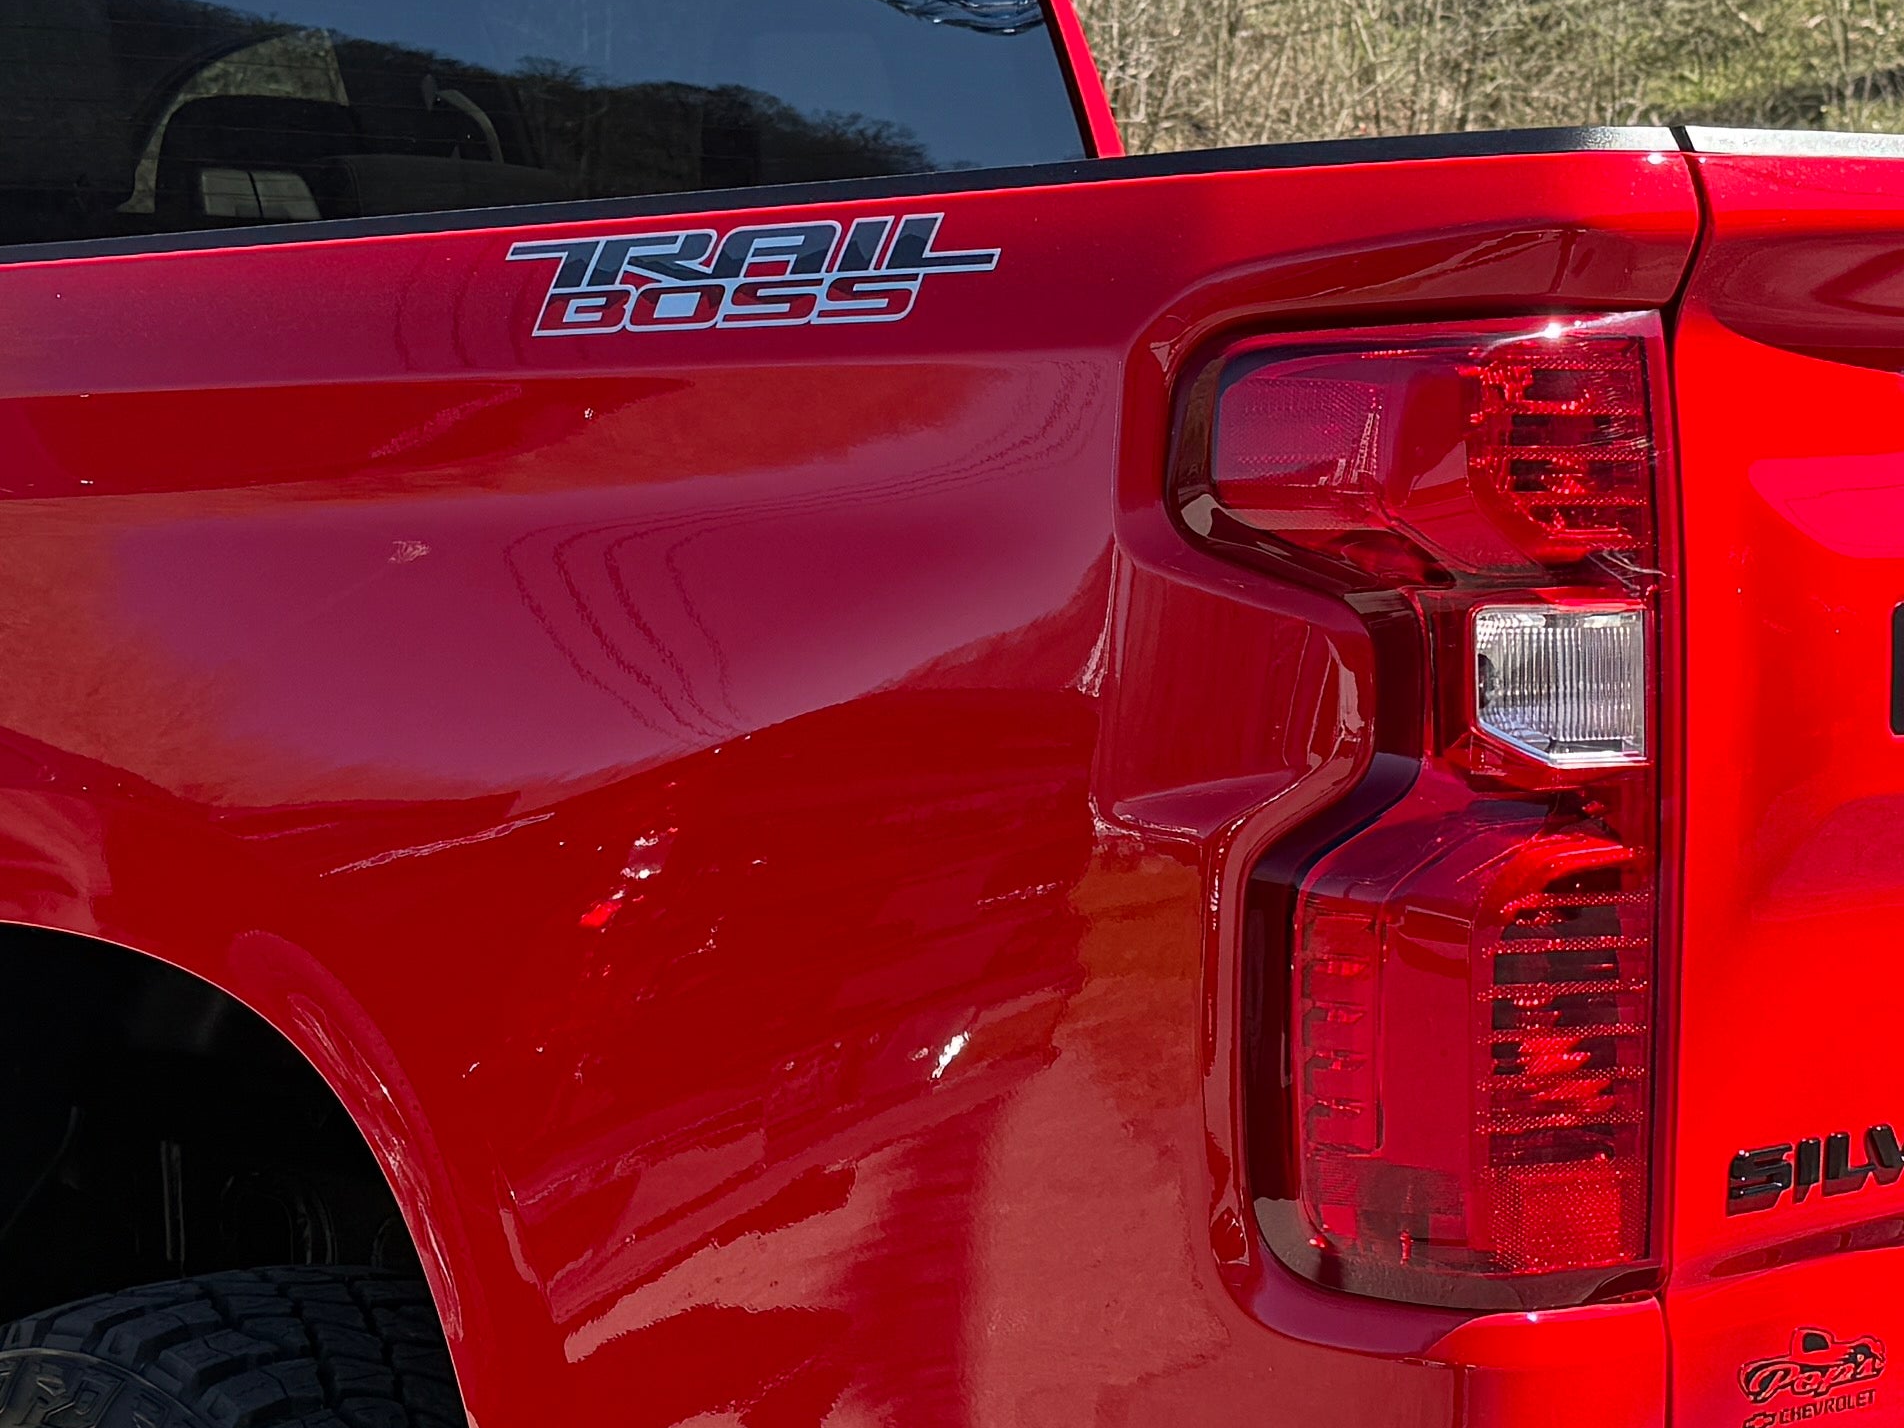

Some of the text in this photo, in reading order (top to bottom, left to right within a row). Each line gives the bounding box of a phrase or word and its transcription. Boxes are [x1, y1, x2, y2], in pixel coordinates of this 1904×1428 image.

[505, 212, 1001, 288] TRAIL
[532, 273, 924, 337] BOSS
[1778, 1388, 1877, 1425] CHEVROLET
